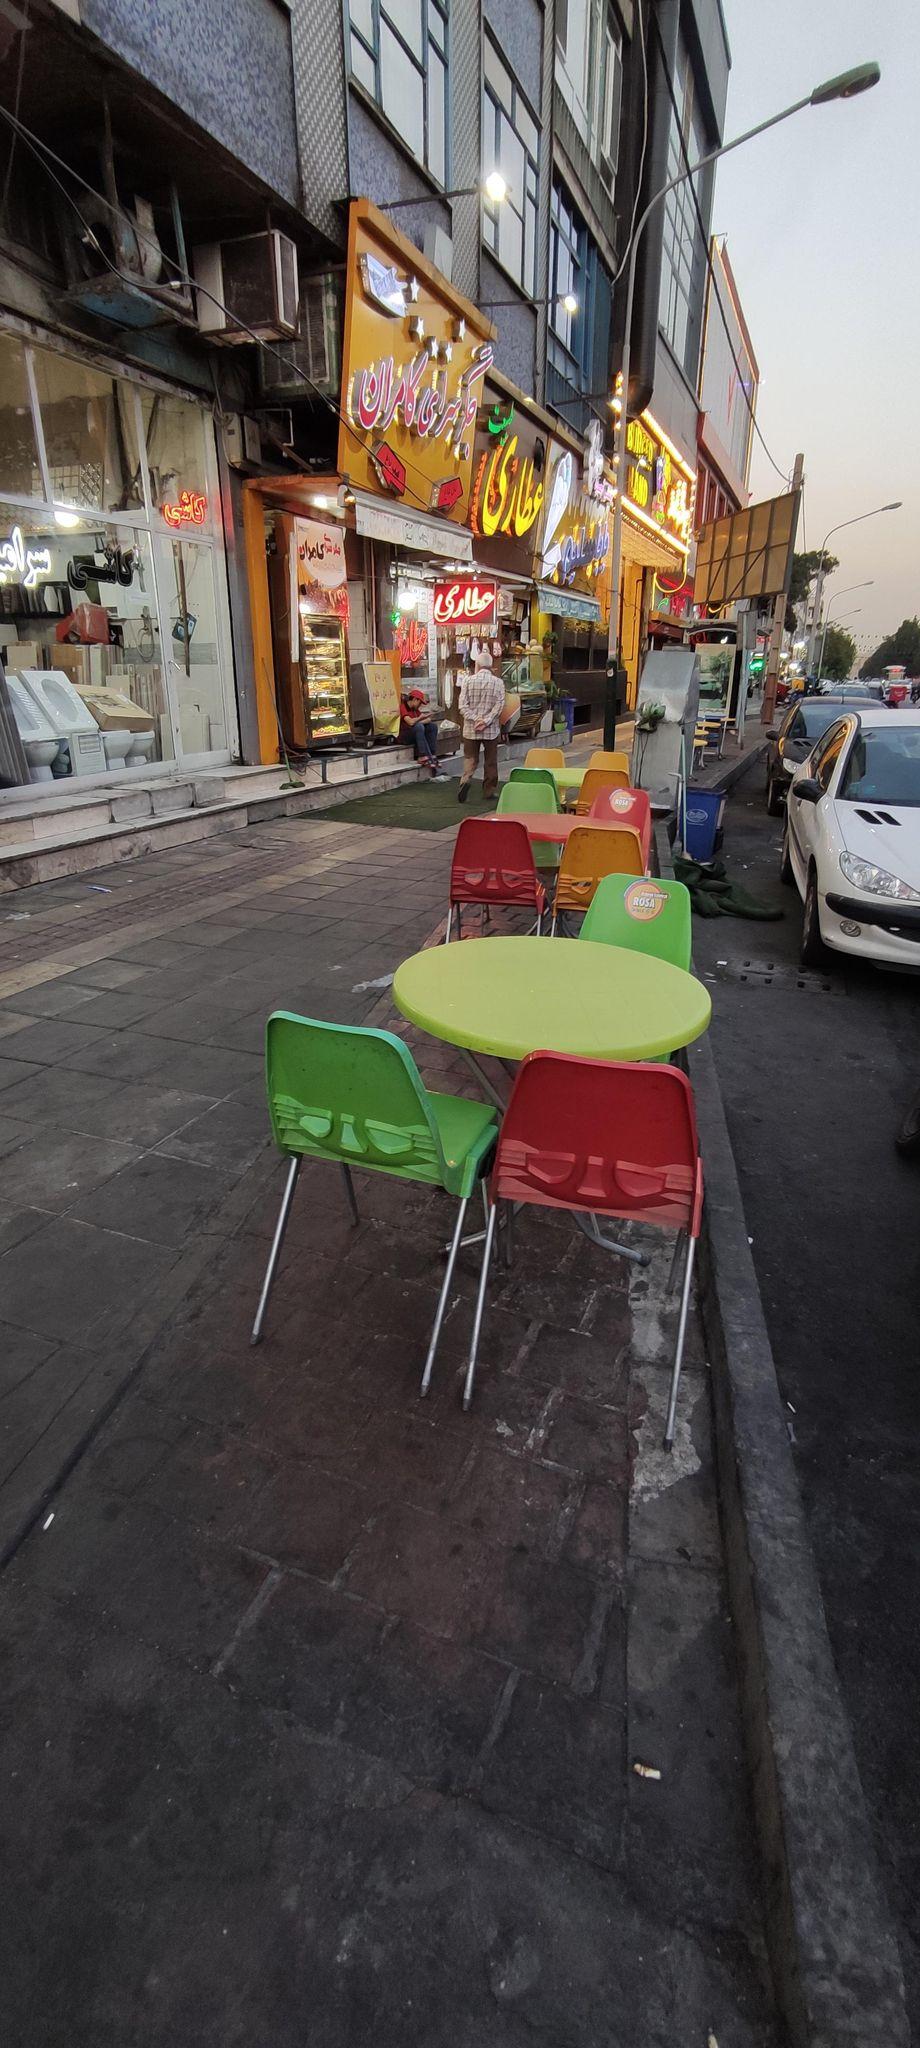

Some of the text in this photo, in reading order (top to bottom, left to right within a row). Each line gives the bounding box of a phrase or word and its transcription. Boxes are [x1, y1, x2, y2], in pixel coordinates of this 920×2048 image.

[358, 352, 429, 432] کامران
[482, 435, 544, 537] عطاری
[163, 491, 207, 527] کاشی
[67, 544, 136, 591] کاشی
[298, 540, 325, 561] کامران
[433, 584, 496, 623] عطاری
[632, 896, 656, 908] ROSA
